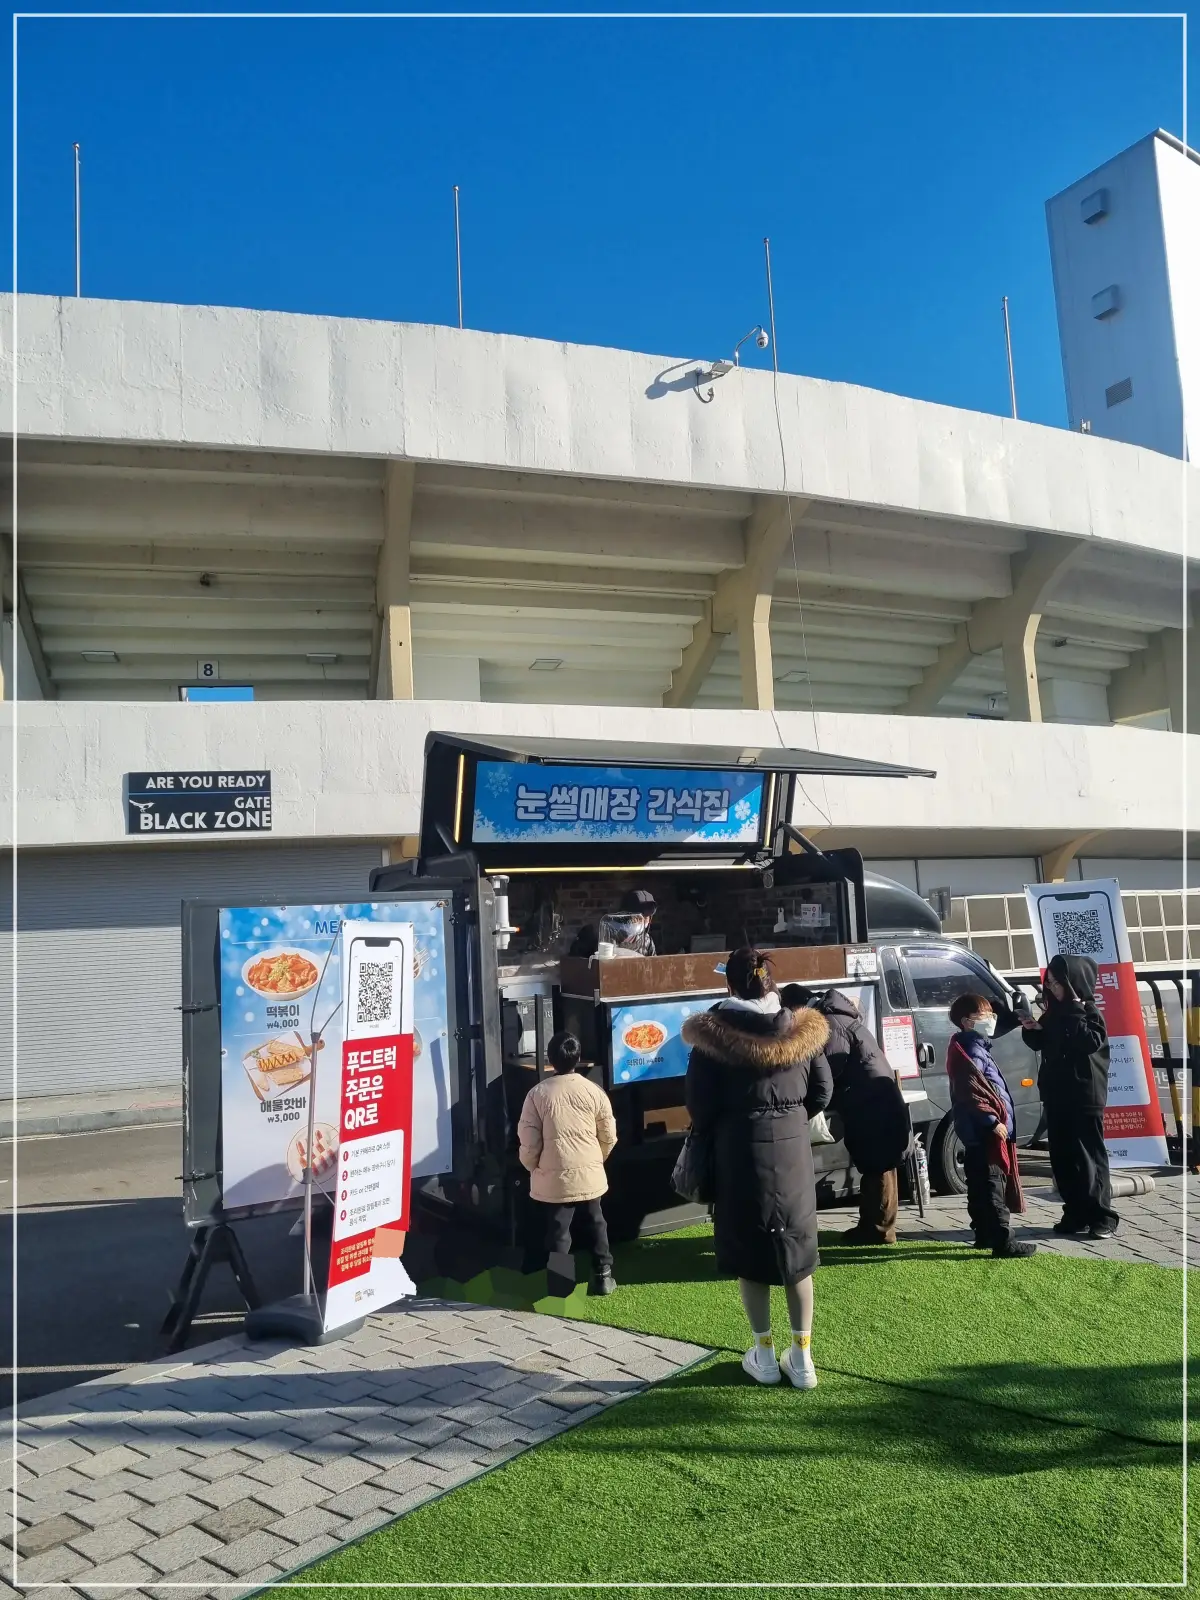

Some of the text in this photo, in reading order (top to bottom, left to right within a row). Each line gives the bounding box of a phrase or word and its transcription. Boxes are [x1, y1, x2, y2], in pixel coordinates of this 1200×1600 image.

[203, 664, 214, 677] 8
[990, 698, 997, 709] 7
[146, 776, 267, 789] ARE YOU READY
[234, 797, 271, 809] GATE
[516, 784, 730, 823] 눈썰매장 간식집
[140, 811, 272, 830] BLACK ZONE
[266, 1004, 300, 1018] 떡볶이
[346, 1045, 397, 1076] 푸드트럭
[345, 1075, 384, 1104] 주문은
[260, 1096, 307, 1113] 해물핫바
[344, 1102, 379, 1130] QR로
